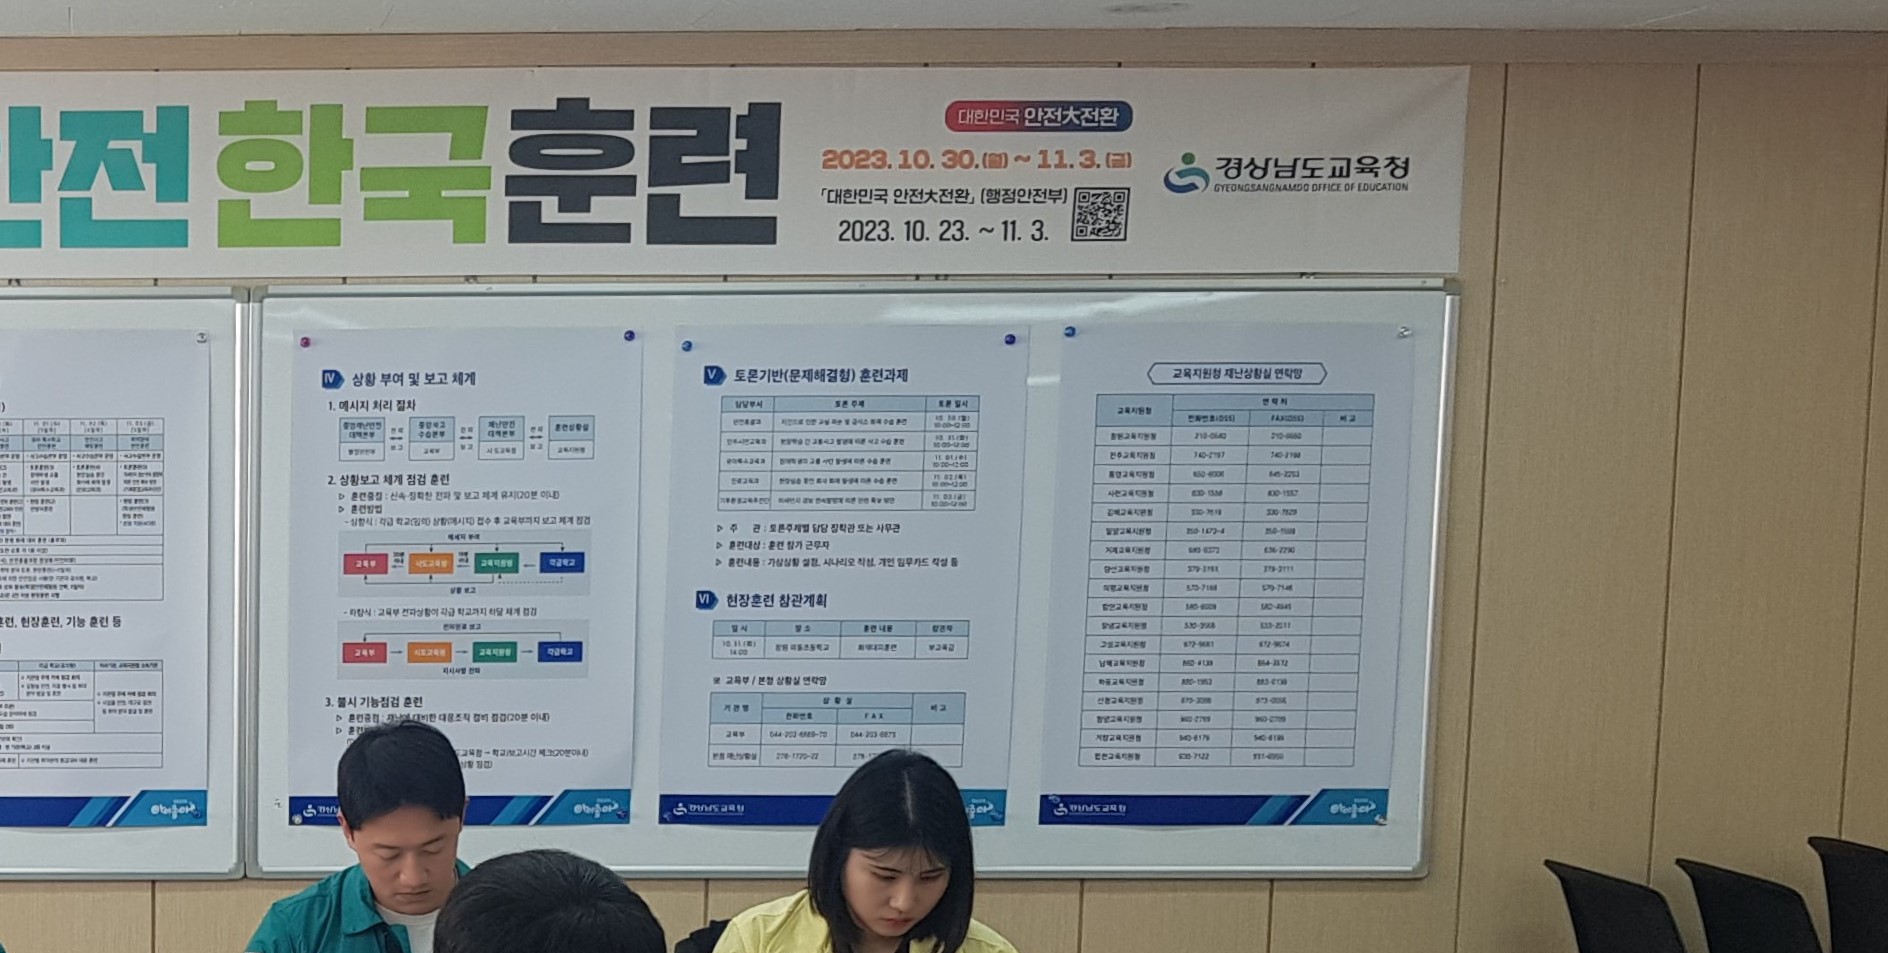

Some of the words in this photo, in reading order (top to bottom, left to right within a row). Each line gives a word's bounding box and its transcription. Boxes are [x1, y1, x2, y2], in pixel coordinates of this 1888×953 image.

[958, 107, 1020, 124] 대한민국
[1024, 107, 1119, 126] 안전大전환
[1216, 156, 1409, 180] 경상남도교육청
[1312, 183, 1342, 192] OFFICE
[1344, 183, 1355, 192] OF
[1358, 183, 1408, 192] EDUCATION
[821, 188, 888, 204] 「대한민국
[894, 188, 974, 204] 안전大전환」
[981, 188, 1067, 204] (행정안전부)
[839, 220, 894, 242] 2023.
[904, 220, 929, 241] 10.
[939, 220, 969, 241] 23.
[1002, 220, 1021, 241] 11.
[1031, 220, 1048, 241] 3.
[353, 373, 376, 387] 상황
[380, 372, 403, 386] 부여
[409, 372, 419, 386] 및
[424, 373, 448, 385] 보고
[452, 372, 475, 386] 체계
[734, 369, 855, 383] 토론기반(문제해결형)
[860, 368, 908, 383] 훈련과제
[1172, 368, 1221, 380] 교육지원청
[1224, 368, 1271, 380] 재난상황실
[1274, 368, 1302, 380] 연락망
[329, 401, 335, 411] 1.
[339, 400, 368, 412] 메시지
[373, 400, 392, 411] 처리
[397, 399, 416, 411] 절차
[328, 475, 336, 485] 2.
[340, 474, 379, 486] 상황보고
[384, 474, 403, 485] 체계
[407, 473, 426, 485] 점검
[431, 473, 449, 485] 훈련
[768, 541, 784, 550] 훈련
[806, 541, 829, 550] 근무자
[727, 594, 774, 608] 현장훈련
[779, 594, 827, 608] 참관계획
[21, 616, 62, 628] 현장훈련,
[67, 616, 85, 628] 기능
[90, 616, 108, 628] 훈련
[113, 616, 121, 627] 등
[726, 676, 749, 685] 교육부
[325, 697, 333, 707] 3.
[337, 696, 356, 708] 불시
[360, 696, 399, 708] 기능점검
[404, 697, 422, 708] 훈련
